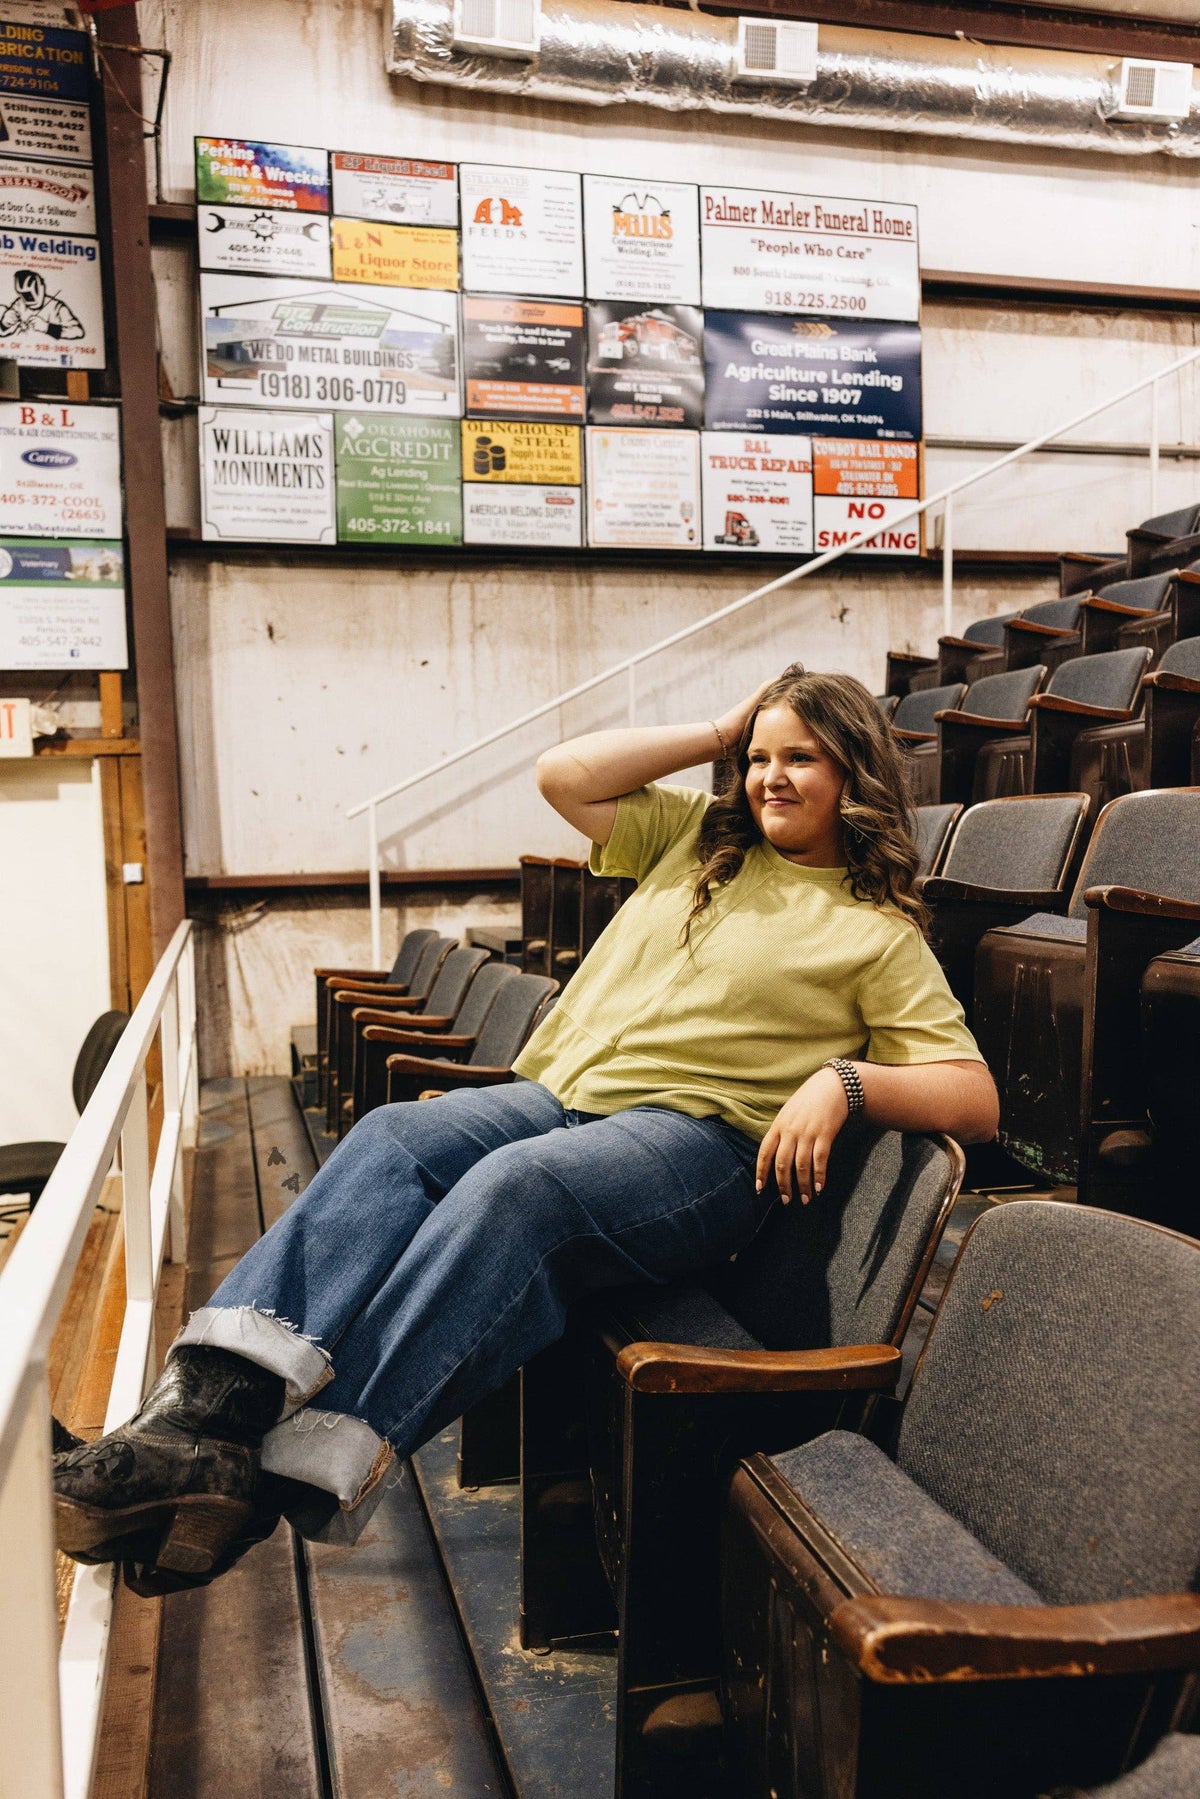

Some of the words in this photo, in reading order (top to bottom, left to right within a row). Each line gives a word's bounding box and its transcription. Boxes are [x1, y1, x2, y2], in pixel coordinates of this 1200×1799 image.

[4, 102, 66, 117] Stillwater,
[70, 110, 87, 119] OK
[199, 142, 254, 160] Perkins
[211, 160, 248, 178] Paint
[251, 164, 262, 179] &
[705, 196, 757, 223] Palmer
[762, 200, 810, 228] Marler
[815, 205, 868, 233] Funeral
[873, 210, 912, 236] Home
[336, 233, 350, 250] L
[468, 227, 528, 239] FEEDS
[19, 236, 97, 261] Welding
[804, 243, 833, 257] Who
[360, 253, 406, 269] Liquor
[412, 258, 453, 272] Store
[765, 290, 867, 311] 918.225.2500
[282, 319, 380, 336] Construction
[251, 341, 272, 360] WE
[277, 344, 294, 361] DO
[299, 345, 339, 364] METAL
[344, 347, 414, 369] BUILDINGS
[751, 340, 792, 358] Great
[794, 343, 838, 361] Plains
[840, 346, 877, 363] Bank
[724, 362, 827, 384] Agriculture
[832, 369, 904, 392] Lending
[260, 372, 310, 399] (918)
[316, 376, 407, 405] 306-0779
[769, 383, 818, 403] Since
[821, 388, 863, 405] 1907
[20, 407, 36, 425] B
[41, 413, 55, 426] &
[61, 409, 75, 427] L
[467, 421, 574, 437] OLINGHOUSE
[212, 428, 323, 458] WILLIAMS
[513, 437, 571, 448] STEEL
[813, 441, 856, 456] COWBOY
[859, 443, 882, 457] BAIL
[883, 444, 917, 459] BONDS
[28, 451, 72, 464] Carrier
[710, 456, 757, 471] TRUCK
[761, 459, 812, 473] REPAIR
[213, 460, 324, 489] MONUMENTS
[371, 465, 386, 479] Ag
[387, 467, 428, 480] Lending
[848, 502, 885, 519] NO
[347, 517, 451, 535] 405-372-1841
